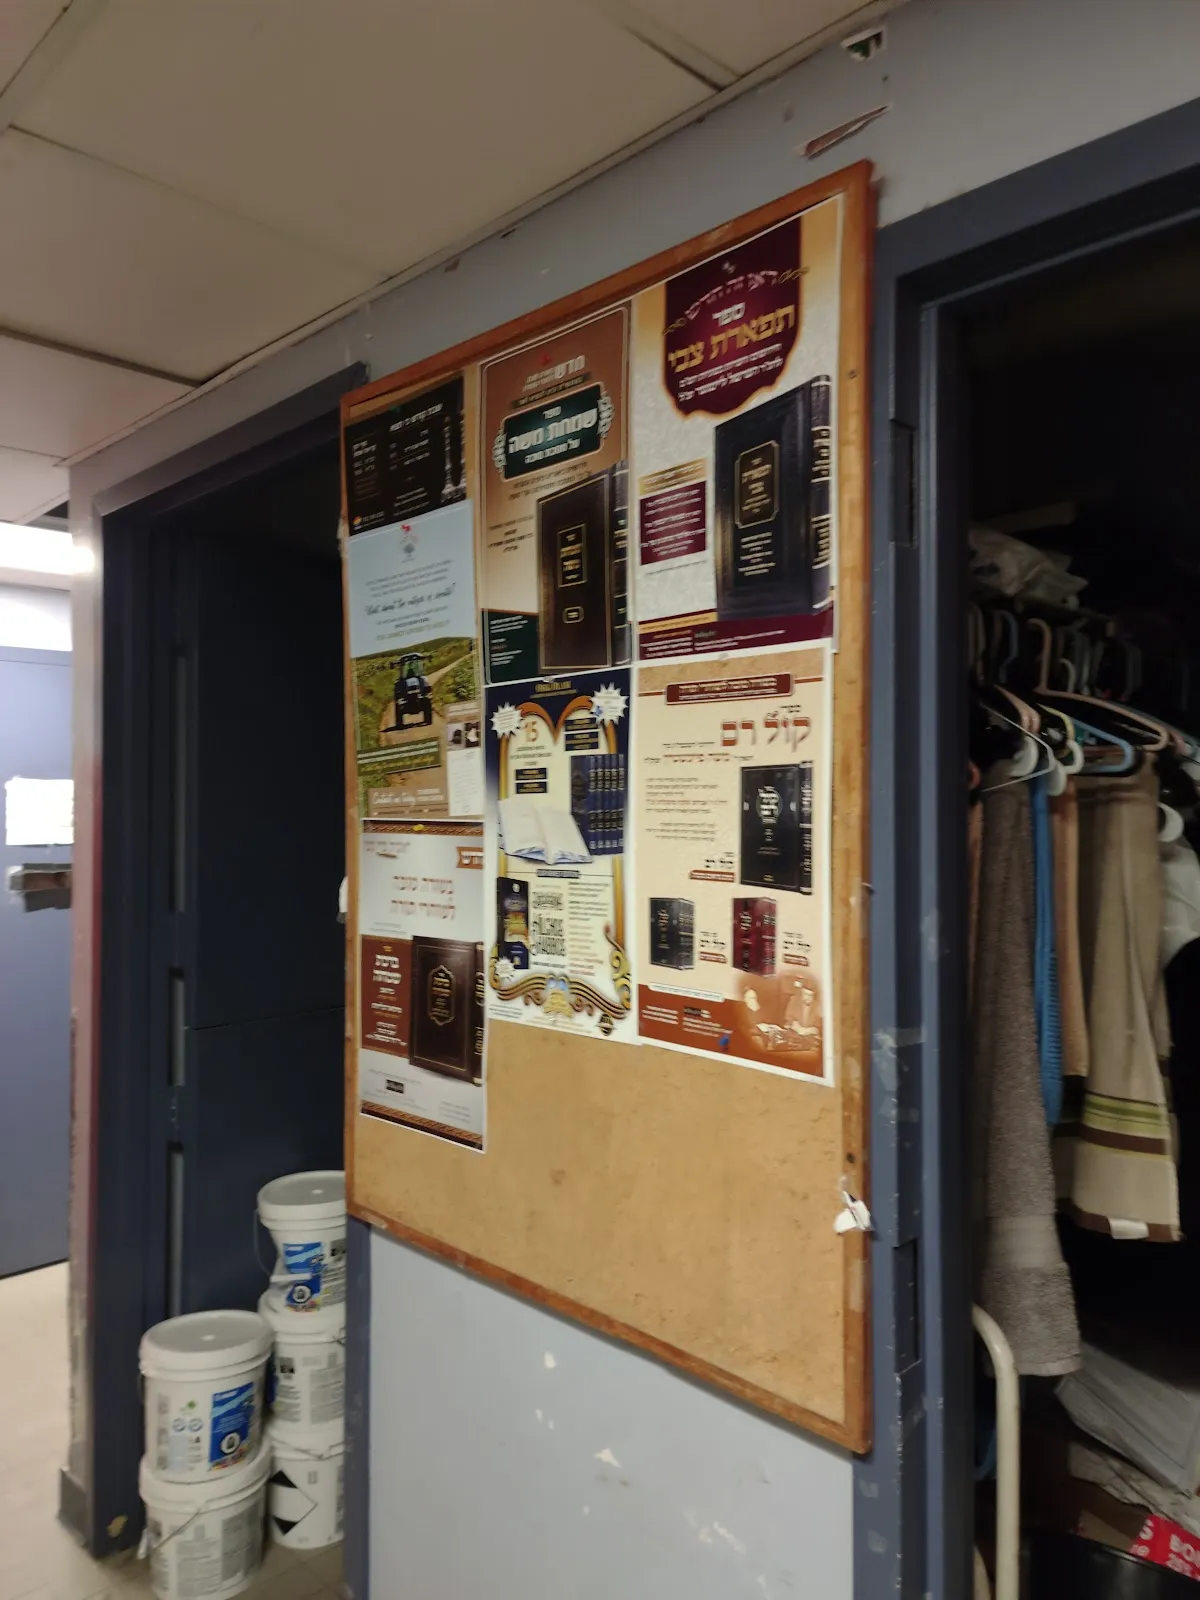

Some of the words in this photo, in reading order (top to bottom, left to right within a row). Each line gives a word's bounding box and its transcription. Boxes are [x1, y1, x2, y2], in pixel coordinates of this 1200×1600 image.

[712, 302, 746, 326] ספר
[709, 304, 796, 360] תפארת
[667, 341, 705, 373] צבי
[508, 424, 544, 455] משה
[546, 406, 598, 441] שמחת
[720, 720, 757, 747] רם
[764, 711, 811, 753] קול
